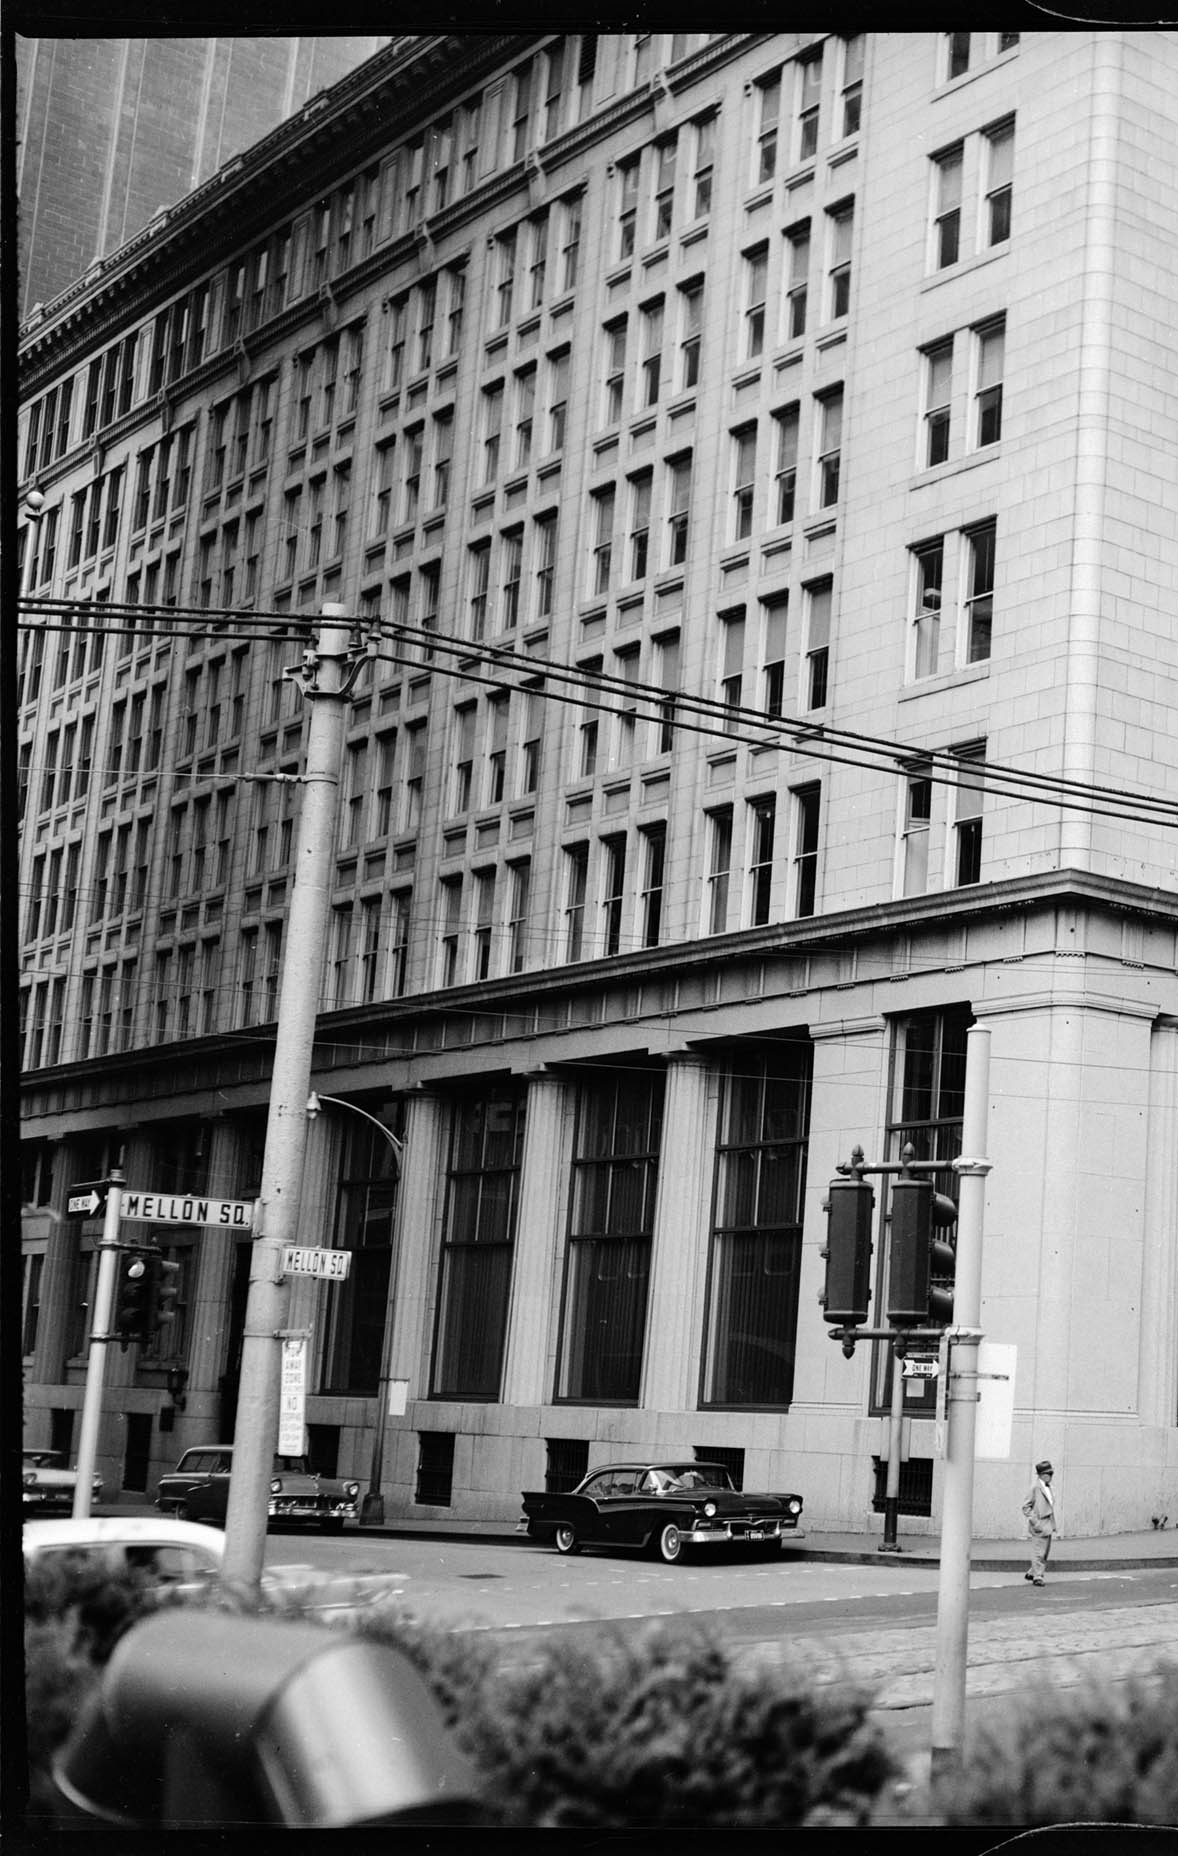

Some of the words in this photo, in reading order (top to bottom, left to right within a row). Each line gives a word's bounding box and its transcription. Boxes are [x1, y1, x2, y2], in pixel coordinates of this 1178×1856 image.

[127, 1195, 209, 1222] MELLON
[219, 1203, 249, 1226] SQ.
[286, 1251, 327, 1273] MELLON
